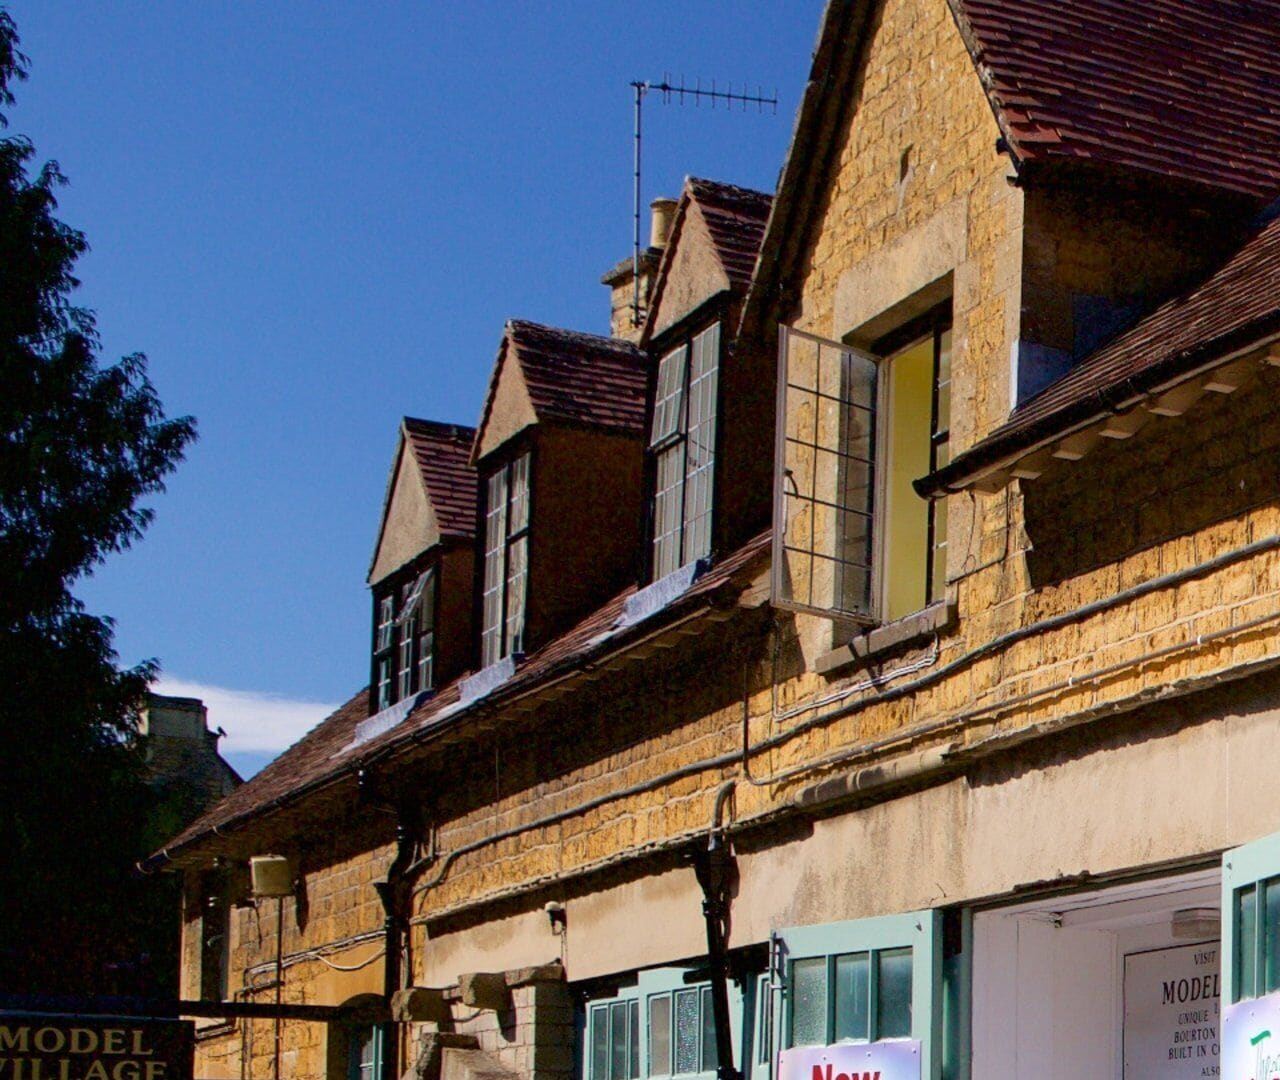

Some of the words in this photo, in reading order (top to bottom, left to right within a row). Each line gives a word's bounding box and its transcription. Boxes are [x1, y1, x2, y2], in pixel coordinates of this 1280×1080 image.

[1194, 950, 1217, 965] VISIT
[1162, 974, 1220, 1005] MODEL
[1178, 1010, 1209, 1025] UNIQUE
[0, 1025, 154, 1056] MODEL
[1174, 1027, 1216, 1043] BOURTON
[1168, 1046, 1193, 1060] BUILT
[1197, 1045, 1207, 1057] IN
